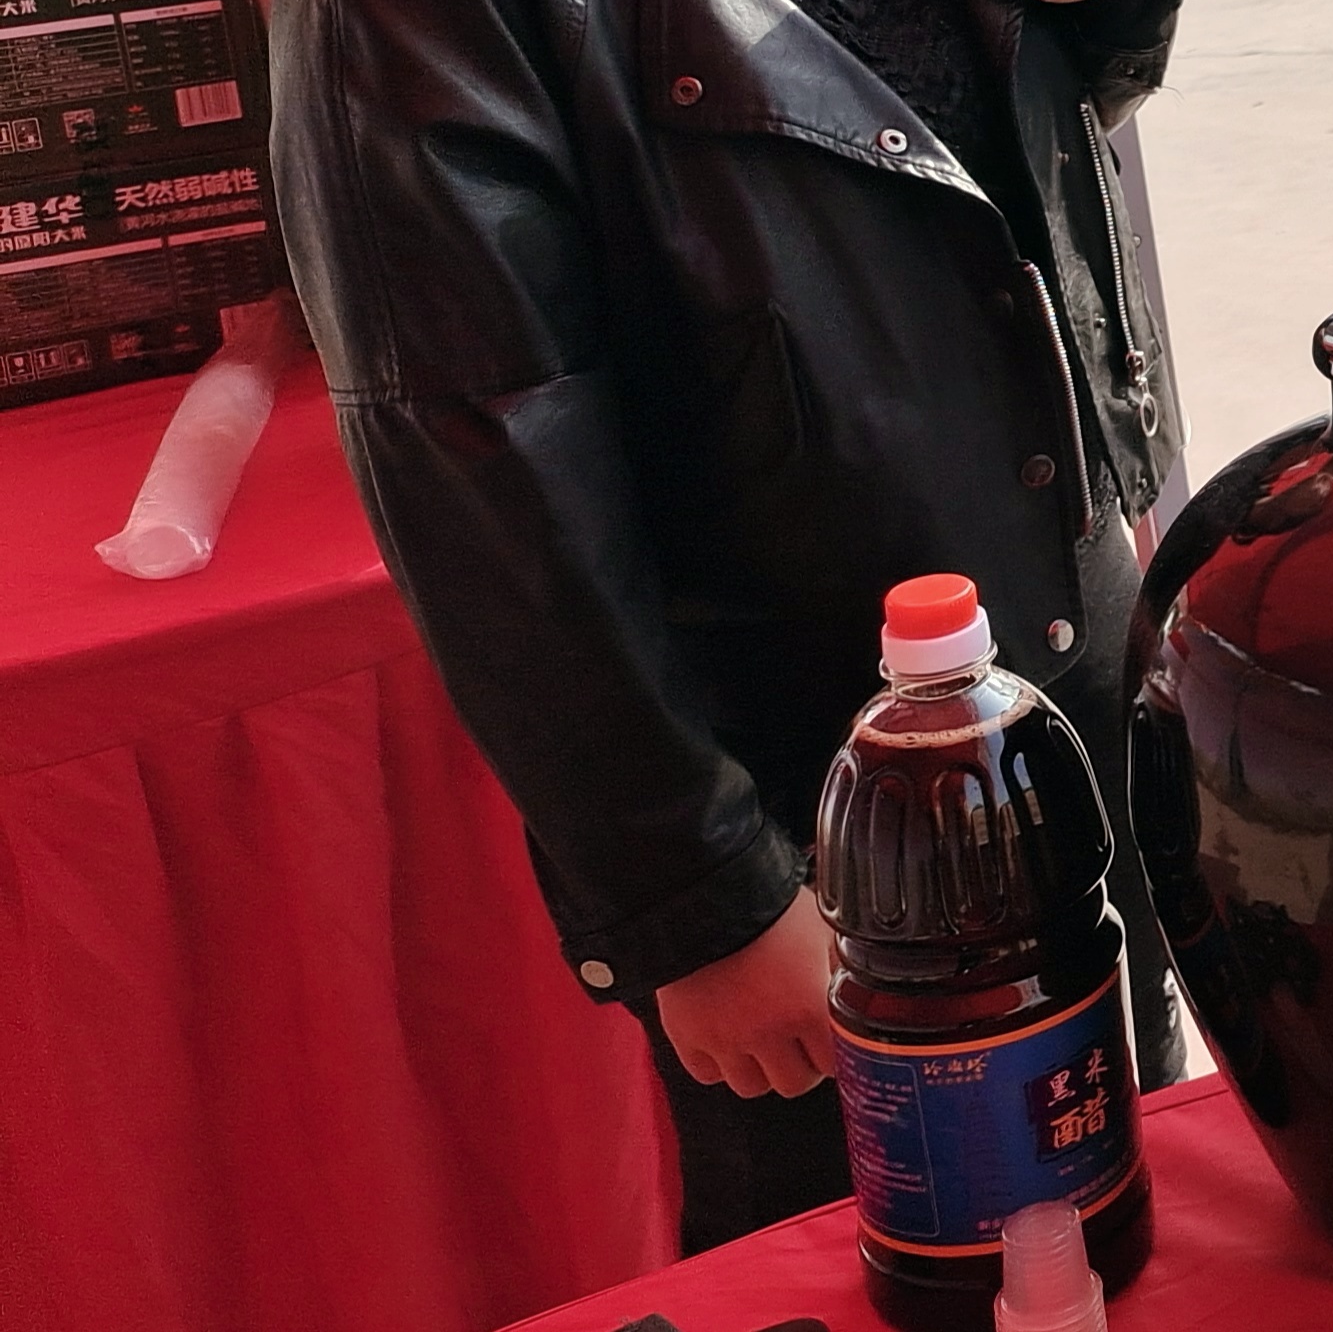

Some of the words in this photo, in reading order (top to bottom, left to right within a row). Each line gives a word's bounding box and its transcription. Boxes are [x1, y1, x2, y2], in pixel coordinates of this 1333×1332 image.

[114, 167, 260, 211] 天然弱碱性
[1050, 1087, 1110, 1149] 醋
